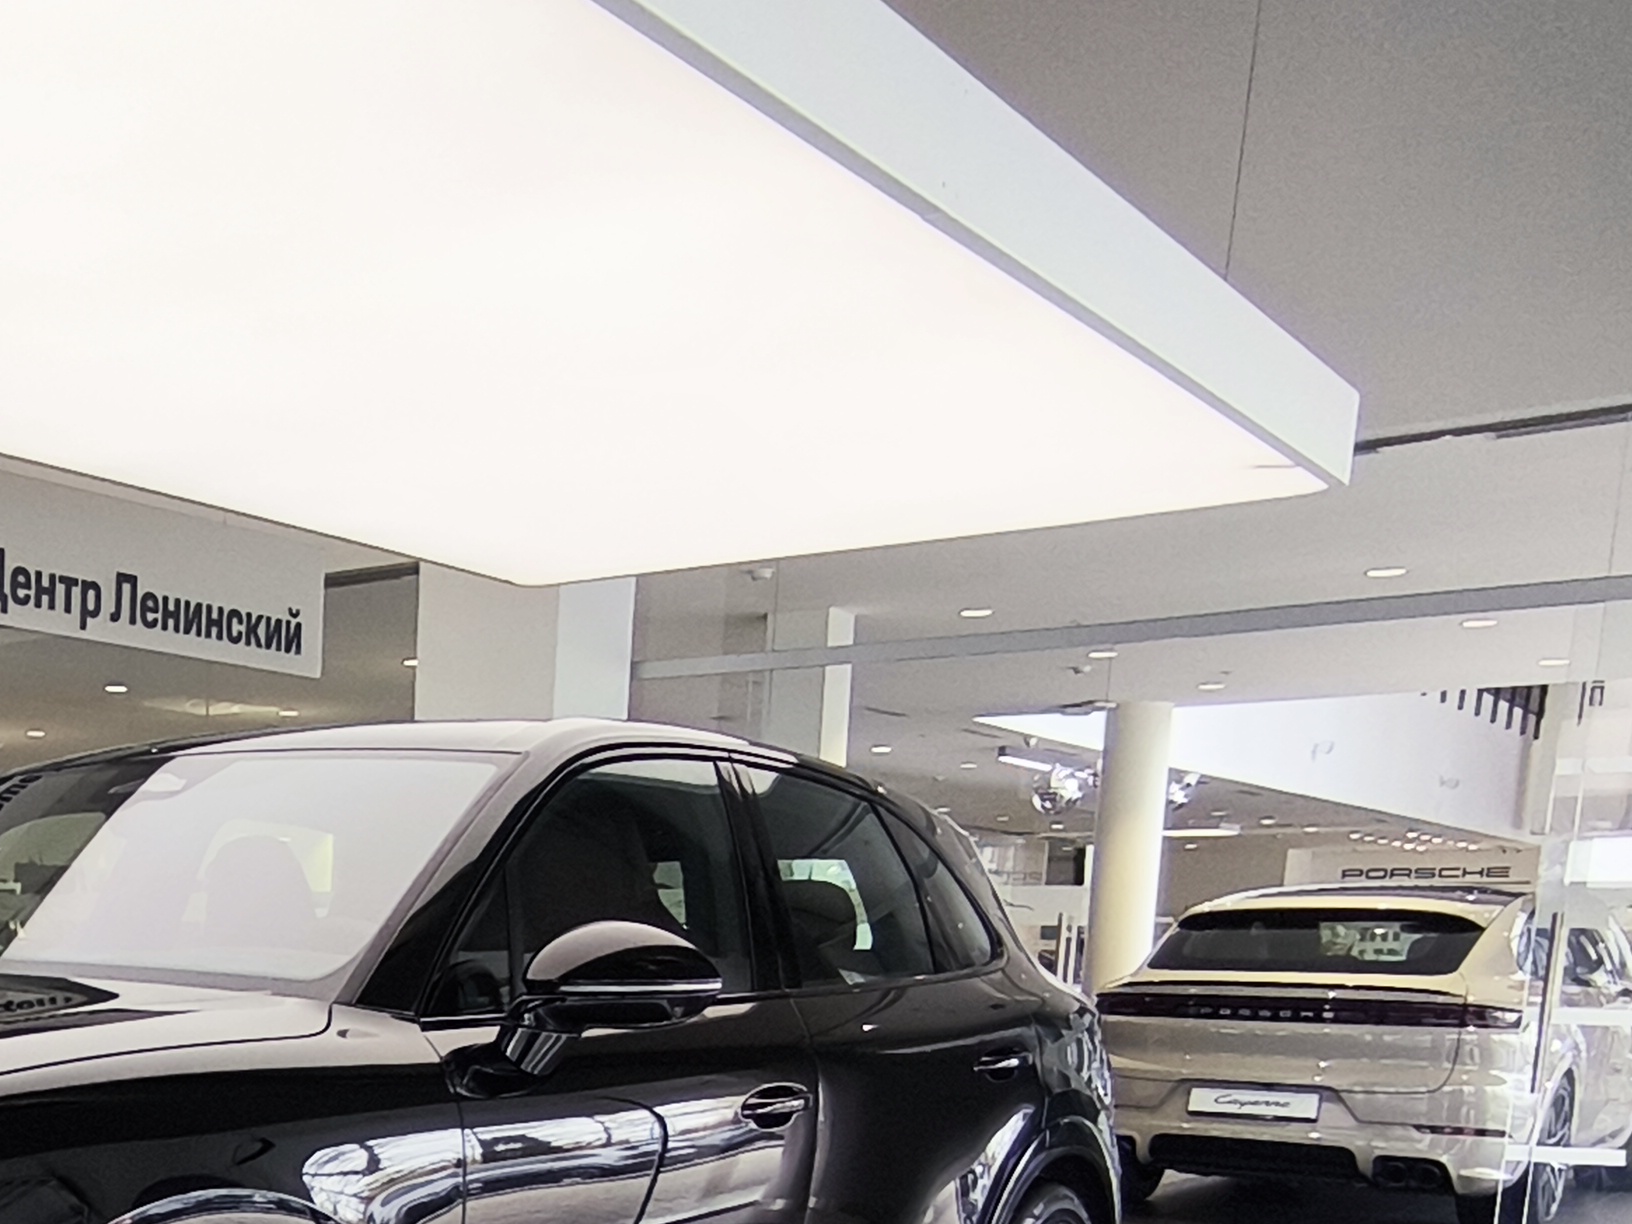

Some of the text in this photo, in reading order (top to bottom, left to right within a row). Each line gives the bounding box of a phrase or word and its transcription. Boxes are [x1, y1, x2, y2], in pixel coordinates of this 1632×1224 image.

[109, 571, 303, 656] Ленинский
[1341, 866, 1512, 880] PORSCHE
[1214, 1094, 1291, 1109] Cayenne
